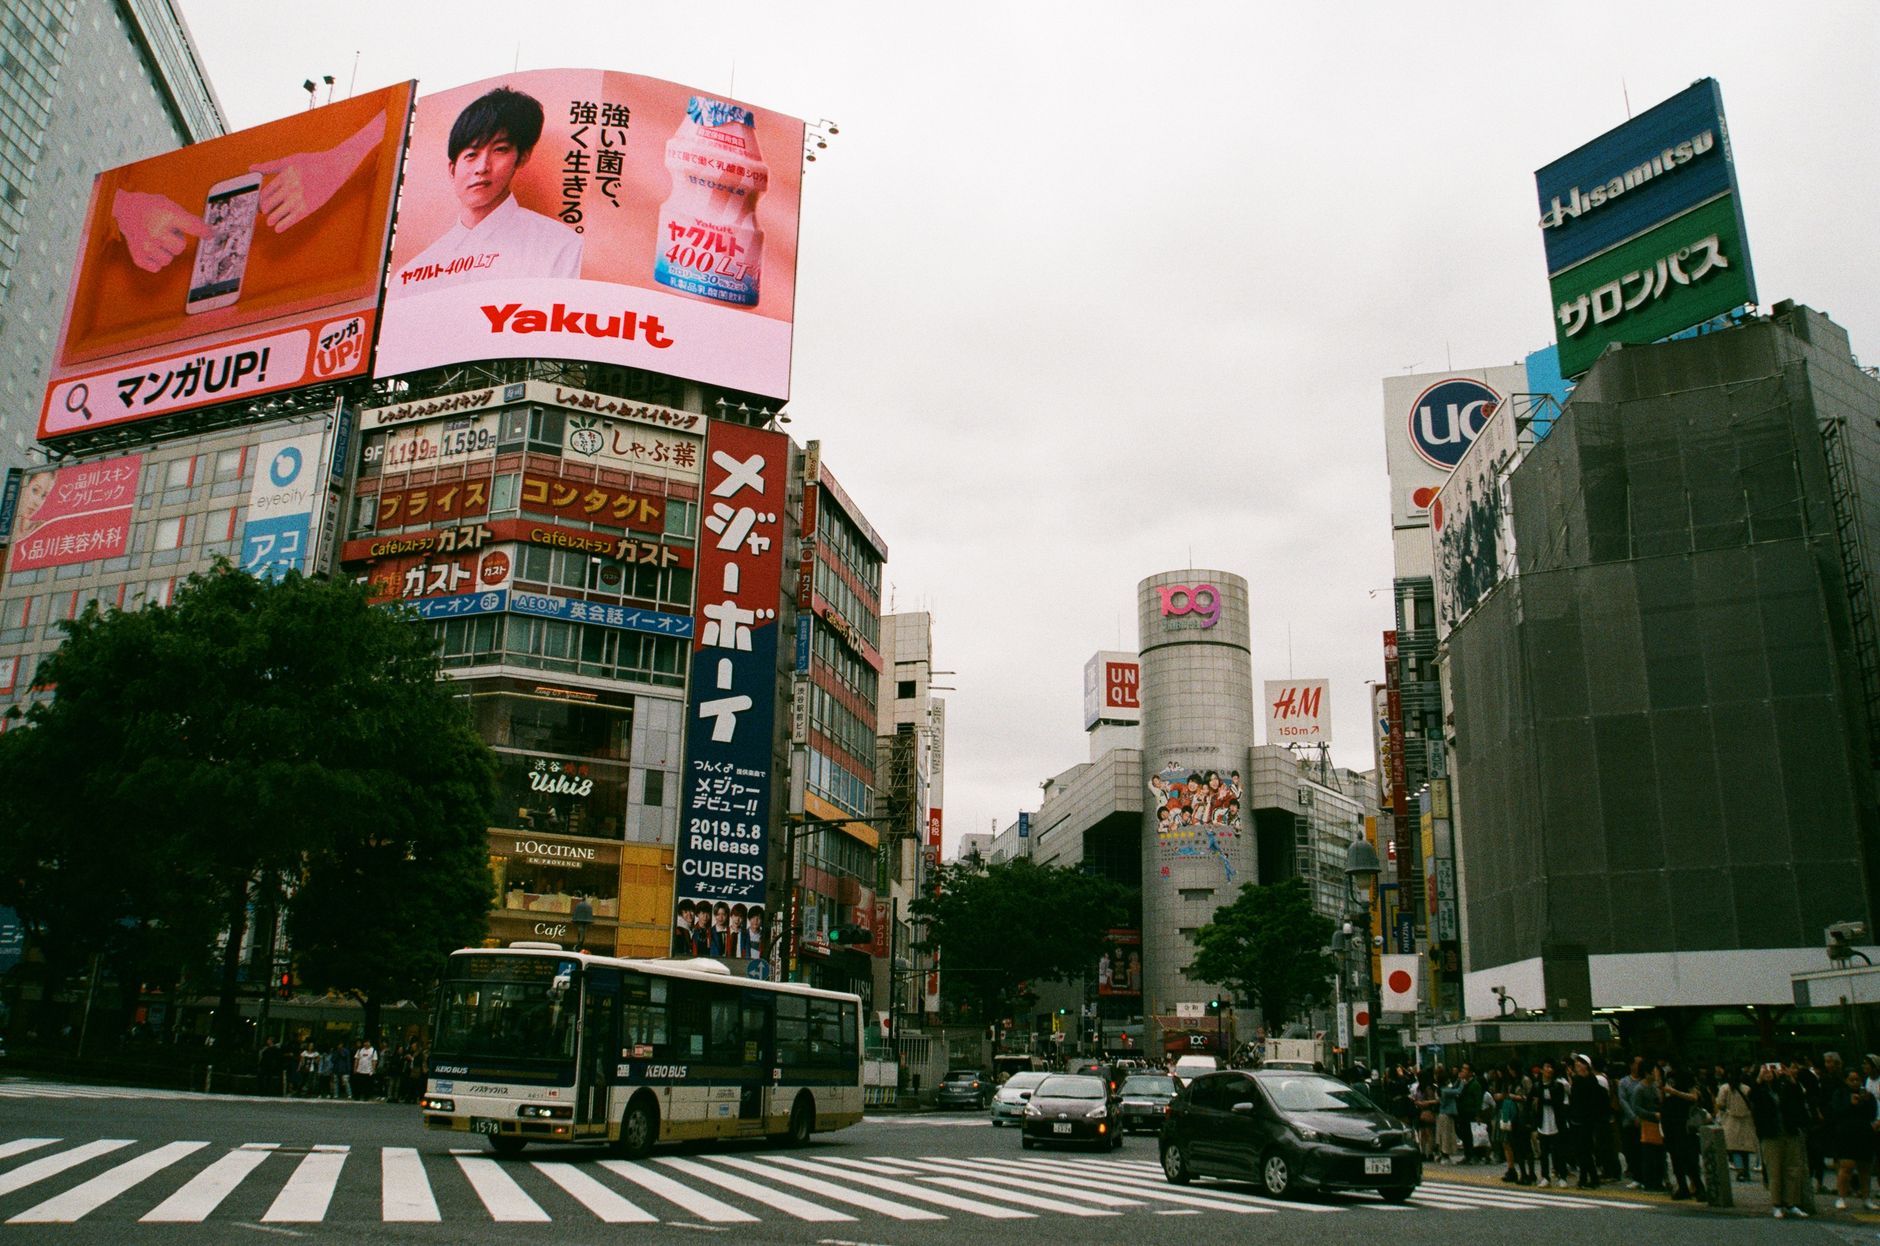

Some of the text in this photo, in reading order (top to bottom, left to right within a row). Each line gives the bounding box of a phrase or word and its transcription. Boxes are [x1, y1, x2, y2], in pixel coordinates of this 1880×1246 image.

[557, 100, 598, 235] 強く生きる。
[597, 103, 630, 208] 強い菌で、
[1538, 129, 1714, 230] Hisamitsu
[668, 221, 744, 257] ヤクルト
[1557, 233, 1728, 337] サロンパス
[320, 318, 360, 350] マンガ
[480, 303, 674, 349] Yakult
[315, 333, 362, 375] UP!
[117, 347, 270, 409] マンガUP!
[377, 390, 494, 423] しゃぶしゃぶバイキング
[556, 388, 699, 429] しゃぶしゃぶバイキング
[364, 445, 384, 462] 9F
[612, 429, 696, 468] しゃぶ葉
[74, 466, 134, 490] 品川スキン
[72, 484, 125, 507] クリニック
[381, 483, 487, 521] プライス
[522, 478, 660, 523] コンタクト
[28, 526, 122, 560] 品川美容外科
[438, 525, 491, 553] ガスト
[615, 538, 679, 567] ガスト
[403, 562, 471, 598] ガスト
[484, 566, 507, 577] ガスト
[482, 593, 499, 610] 6F
[516, 595, 560, 614] AEON
[699, 450, 777, 743] メジャーボーイ
[1156, 584, 1220, 628] 109
[1111, 668, 1136, 684] UN
[1273, 686, 1322, 720] H&M
[528, 771, 594, 797] Ushi8
[695, 776, 760, 796] メジャー
[692, 793, 758, 816] デビュー!!
[690, 818, 761, 840] 2019.5.8
[514, 840, 595, 860] L'OCCITANE
[690, 834, 760, 856] Release
[682, 858, 764, 882] CUBERS
[694, 881, 755, 896] キューバーズ
[534, 922, 567, 938] Café
[435, 1065, 469, 1074] KEIO BUS
[645, 1064, 687, 1079] KEIO BUS
